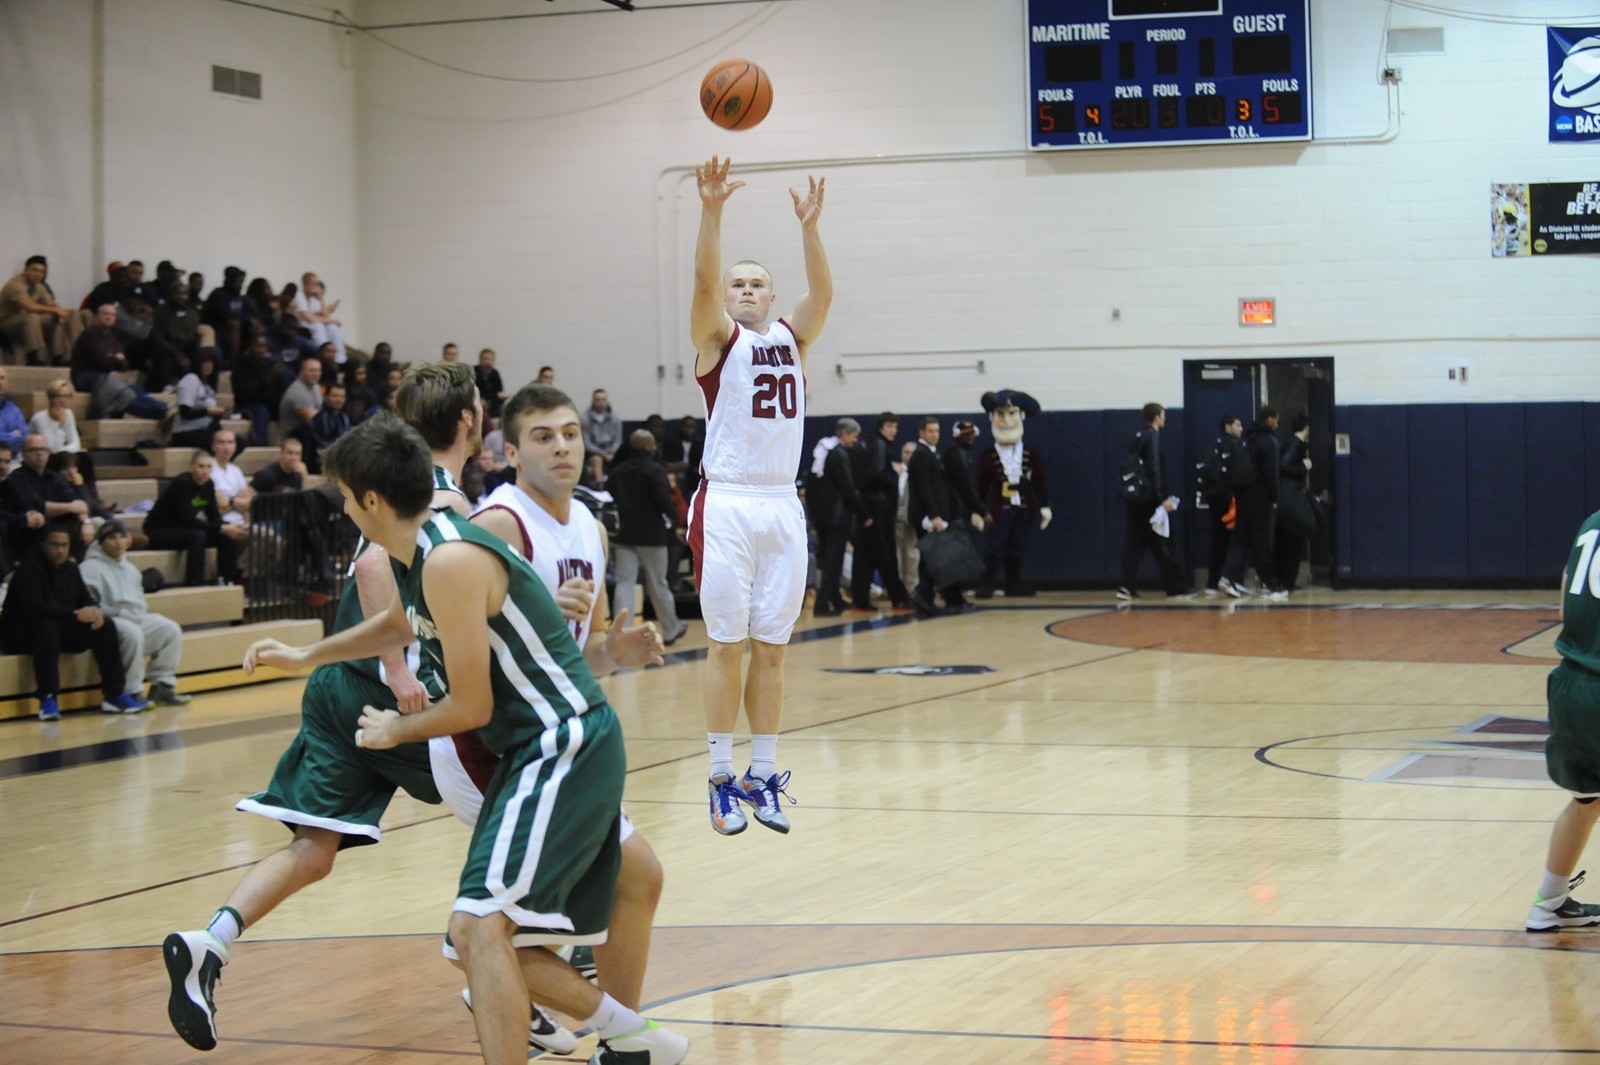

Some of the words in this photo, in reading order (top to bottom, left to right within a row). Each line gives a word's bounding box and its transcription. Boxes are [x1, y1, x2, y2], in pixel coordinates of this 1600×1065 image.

[1233, 14, 1286, 34] GUEST
[1032, 23, 1111, 42] MARITIME
[1146, 29, 1186, 42] PERIOD
[1153, 84, 1181, 97] FOUL
[1195, 82, 1216, 95] PTS
[1262, 79, 1299, 92] FOULS
[1038, 89, 1074, 102] FOULS
[1115, 86, 1142, 99] PLYR
[1238, 99, 1251, 121] 3
[1263, 96, 1279, 122] 5
[1039, 105, 1055, 131] 5
[1086, 107, 1100, 125] 4
[1078, 132, 1108, 145] T.O.L.
[1229, 126, 1259, 139] T.O.L.
[1583, 183, 1598, 193] BE
[1576, 192, 1593, 204] BE
[1566, 201, 1585, 215] BE
[1549, 225, 1573, 233] Division
[752, 373, 797, 419] 20
